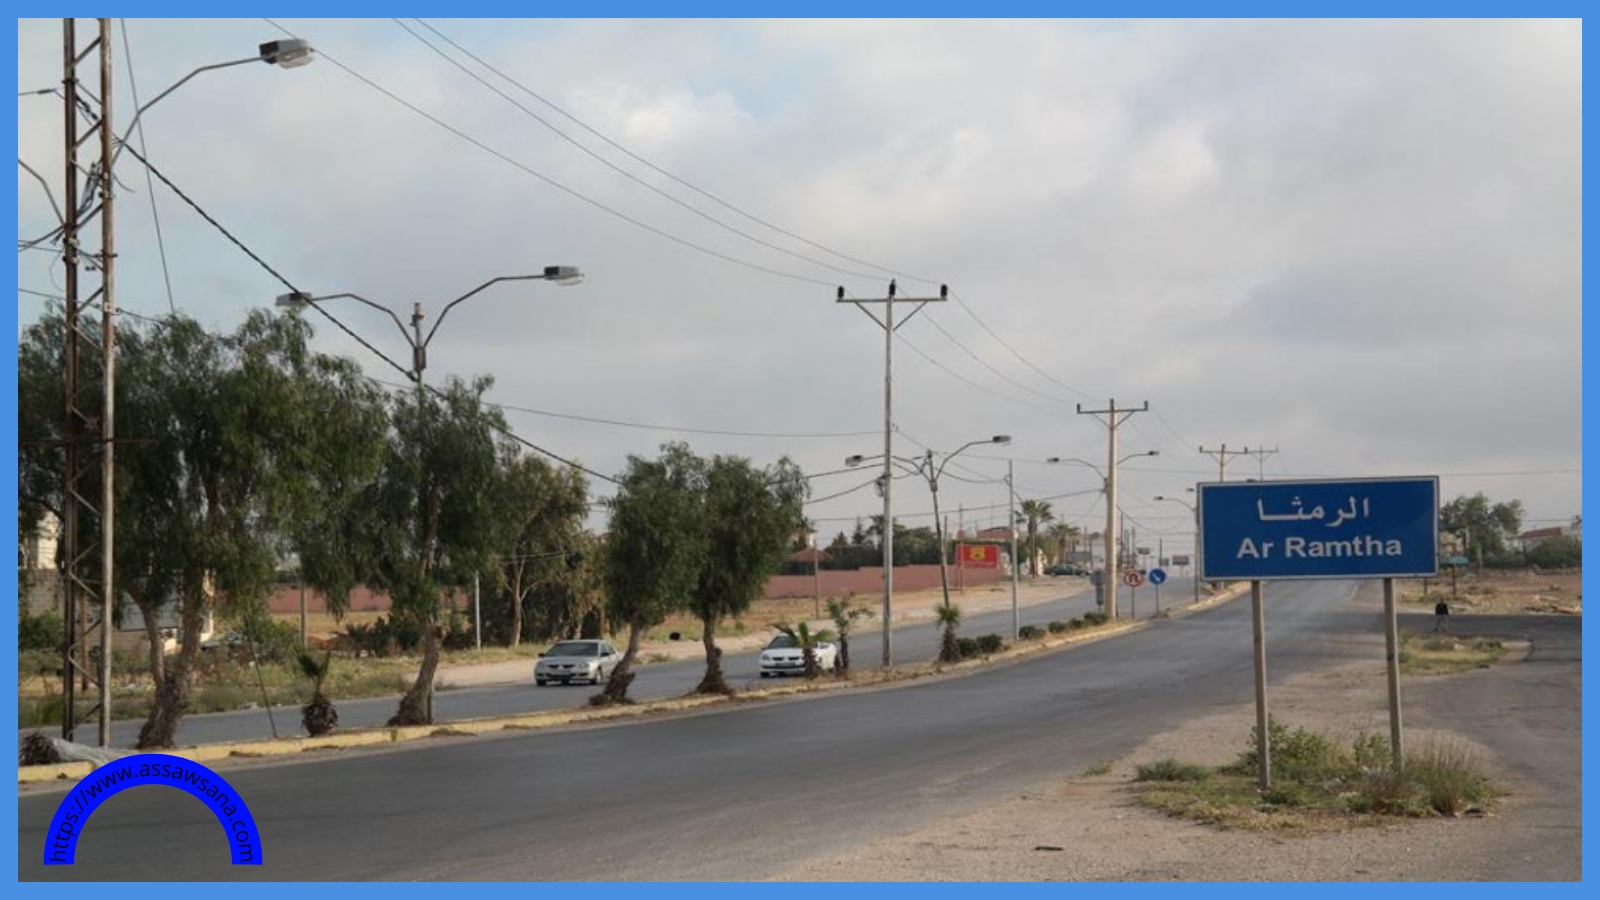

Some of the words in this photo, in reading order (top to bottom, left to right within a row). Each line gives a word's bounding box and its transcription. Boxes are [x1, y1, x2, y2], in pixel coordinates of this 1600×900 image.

[1257, 496, 1369, 526] الرمثا
[1237, 538, 1274, 558] Ar
[1285, 535, 1402, 557] Ramtha
